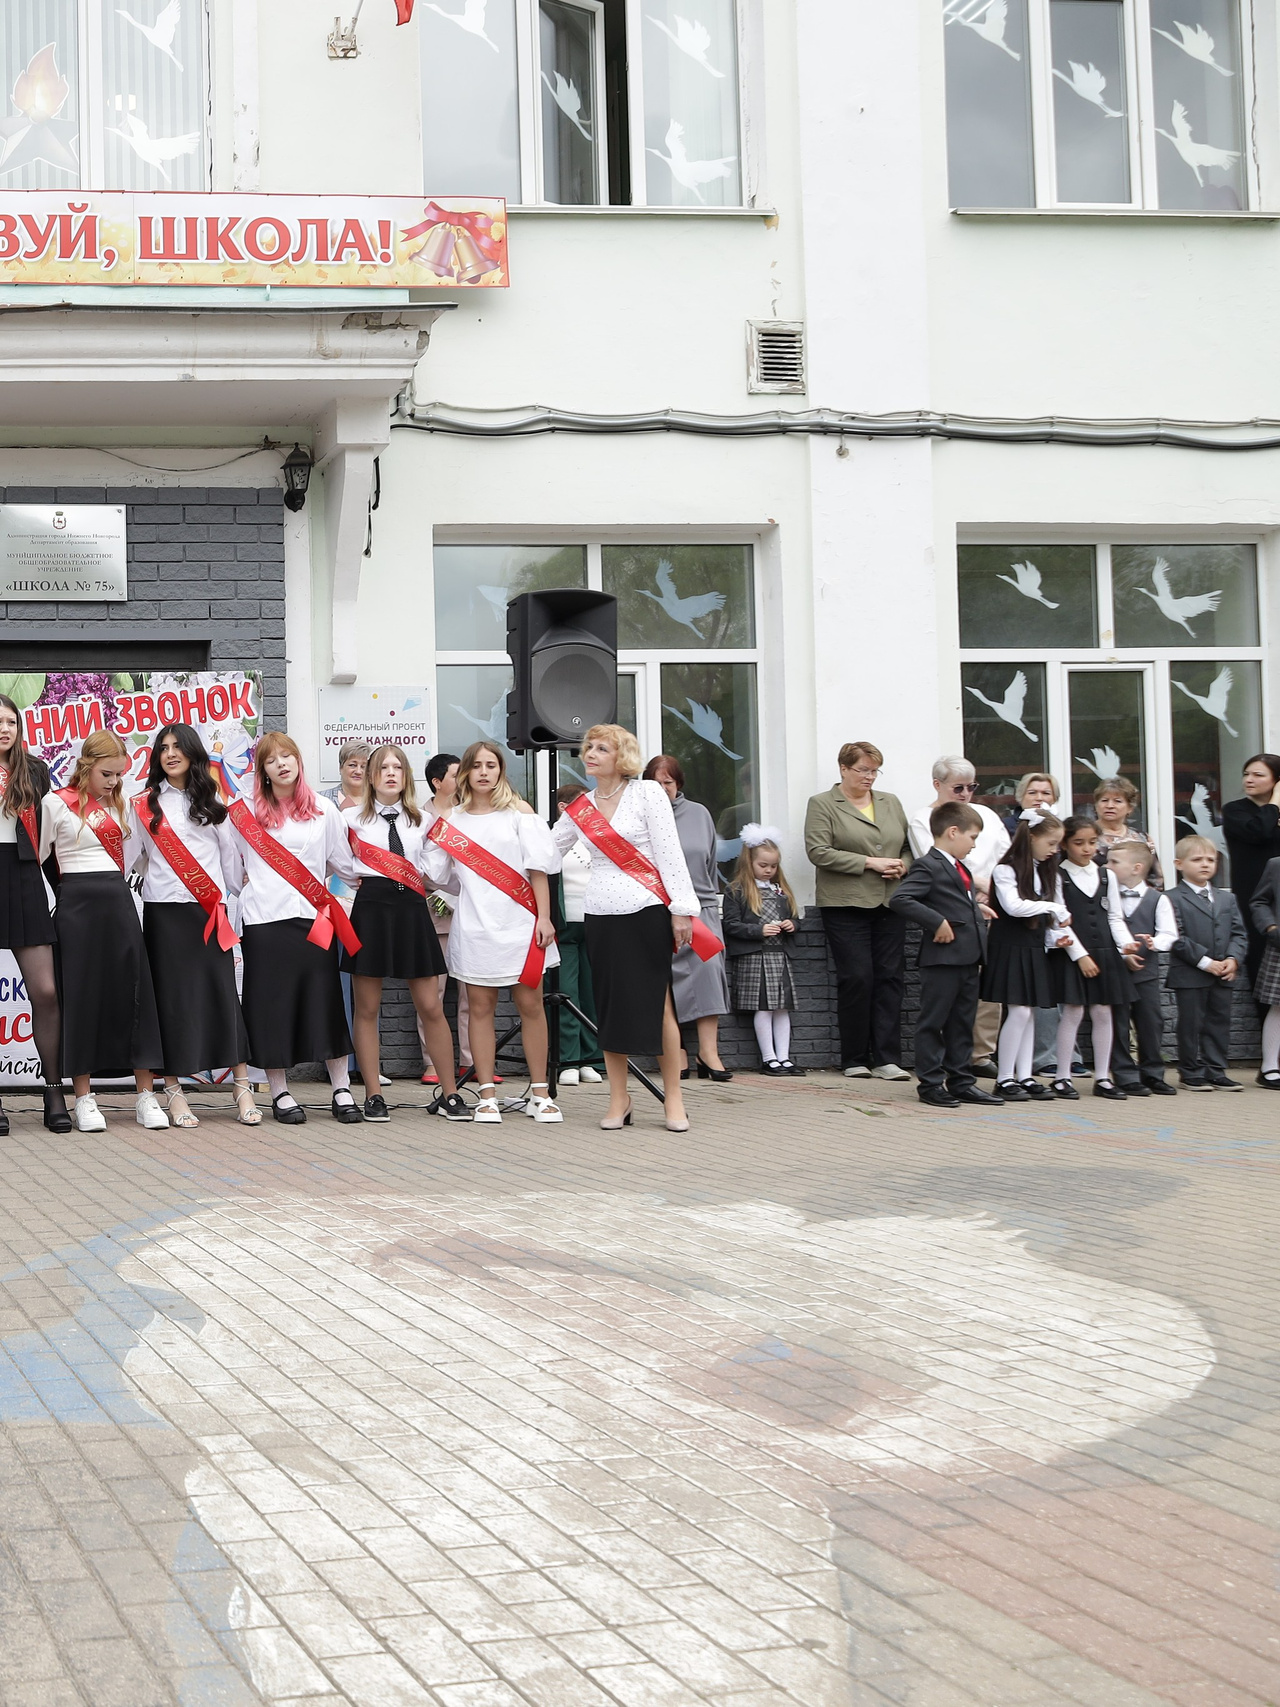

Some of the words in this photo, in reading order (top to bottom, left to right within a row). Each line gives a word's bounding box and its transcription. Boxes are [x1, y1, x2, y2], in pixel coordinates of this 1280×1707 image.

[139, 216, 392, 262] ШКОЛА!
[5, 580, 70, 592] «ШКОЛА
[74, 580, 91, 592] №
[94, 580, 115, 592] 75»
[115, 681, 256, 735] ЗВОНОК
[323, 722, 390, 732] ФЕДЕРАЛЬНЫЙ
[392, 722, 426, 731] ПРОЕКТ
[366, 735, 426, 746] КАЖДОГО
[245, 823, 300, 880] Выпускница
[447, 834, 513, 887] Выпускница
[182, 866, 218, 900] 2025
